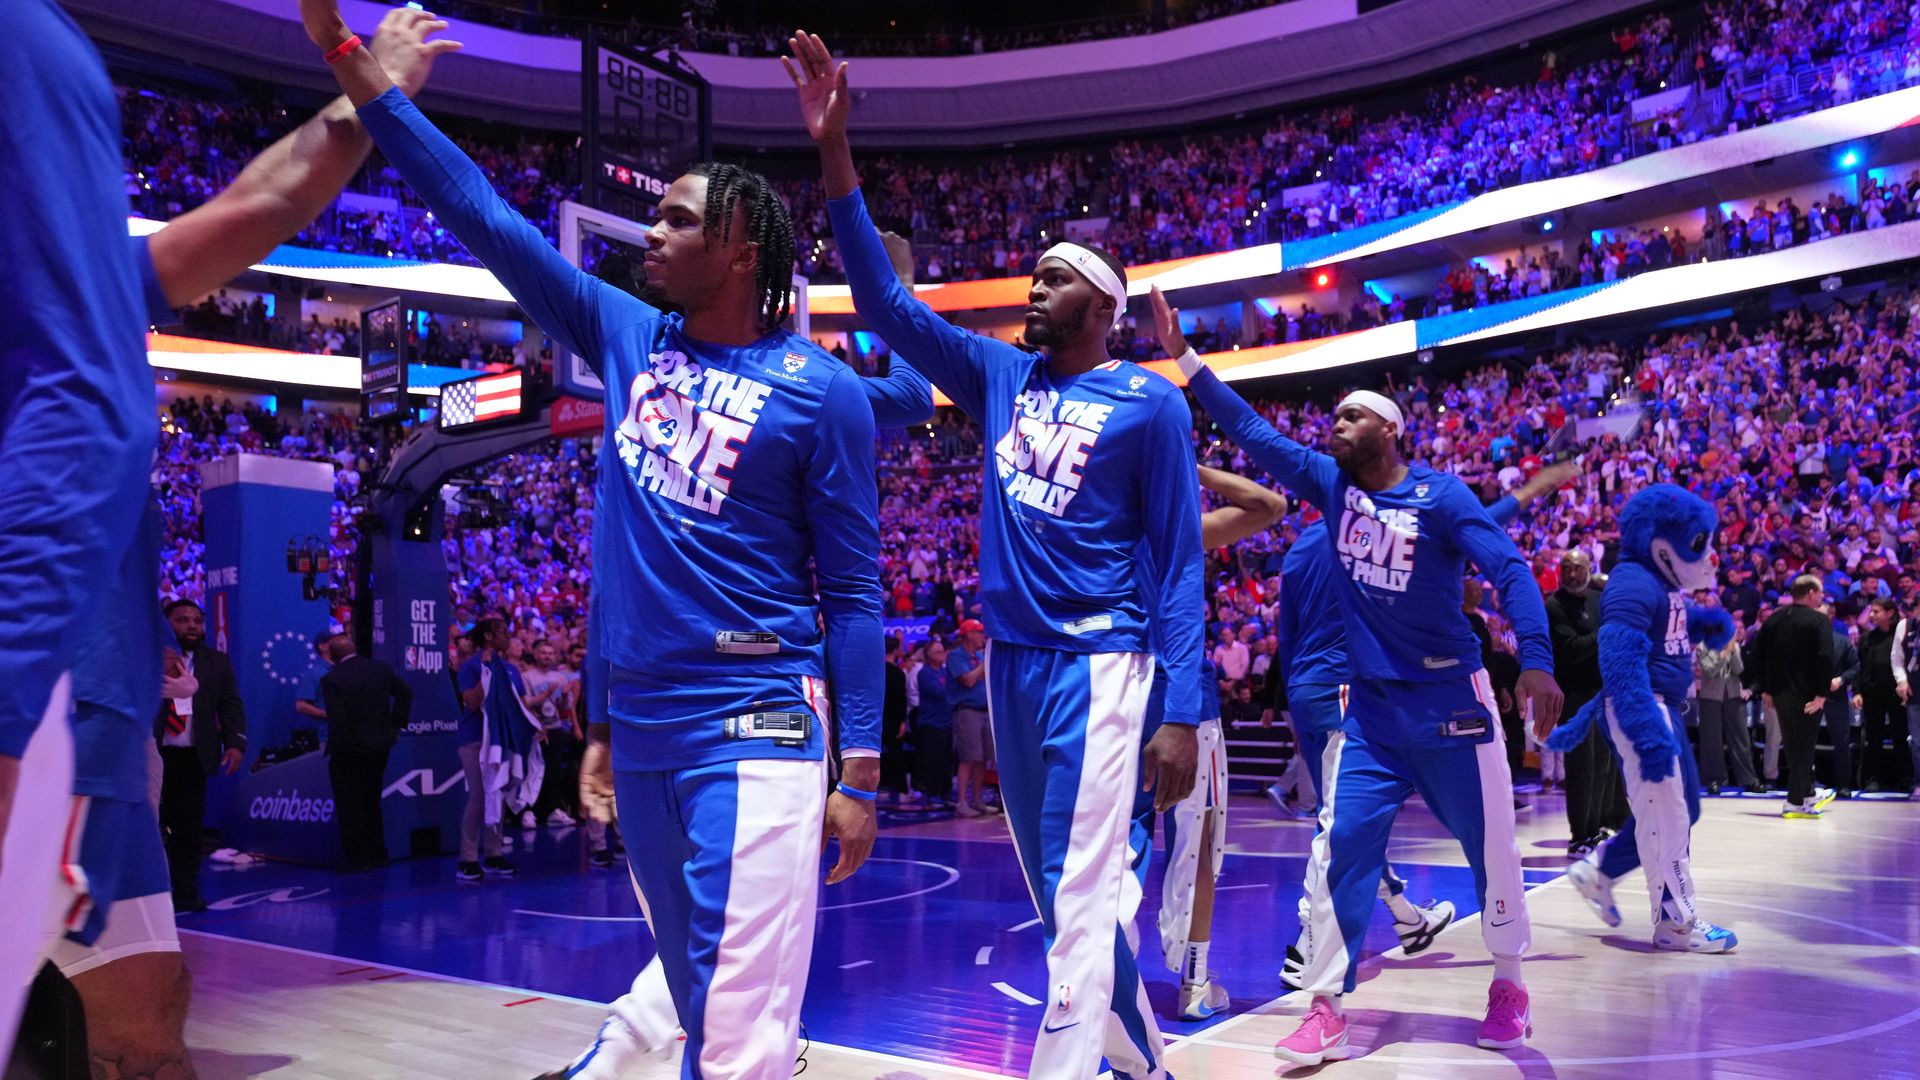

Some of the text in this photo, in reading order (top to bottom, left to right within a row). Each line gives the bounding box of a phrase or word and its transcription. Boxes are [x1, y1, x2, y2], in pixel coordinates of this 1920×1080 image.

[697, 367, 774, 425] THE
[1014, 388, 1114, 433] FOR THE
[619, 371, 753, 495] LOVE
[995, 403, 1099, 491] LOVE
[637, 450, 727, 516] PHILLY
[1006, 471, 1078, 518] PHILLY
[1344, 485, 1419, 533] FOR THE
[1337, 509, 1418, 571] LOVE
[1352, 530, 1371, 548] 76
[1352, 559, 1413, 593] PHILLY
[411, 599, 437, 622] GET
[410, 622, 437, 645] THE
[417, 646, 443, 674] App
[433, 720, 458, 732] Pixel
[250, 789, 335, 823] coinbase
